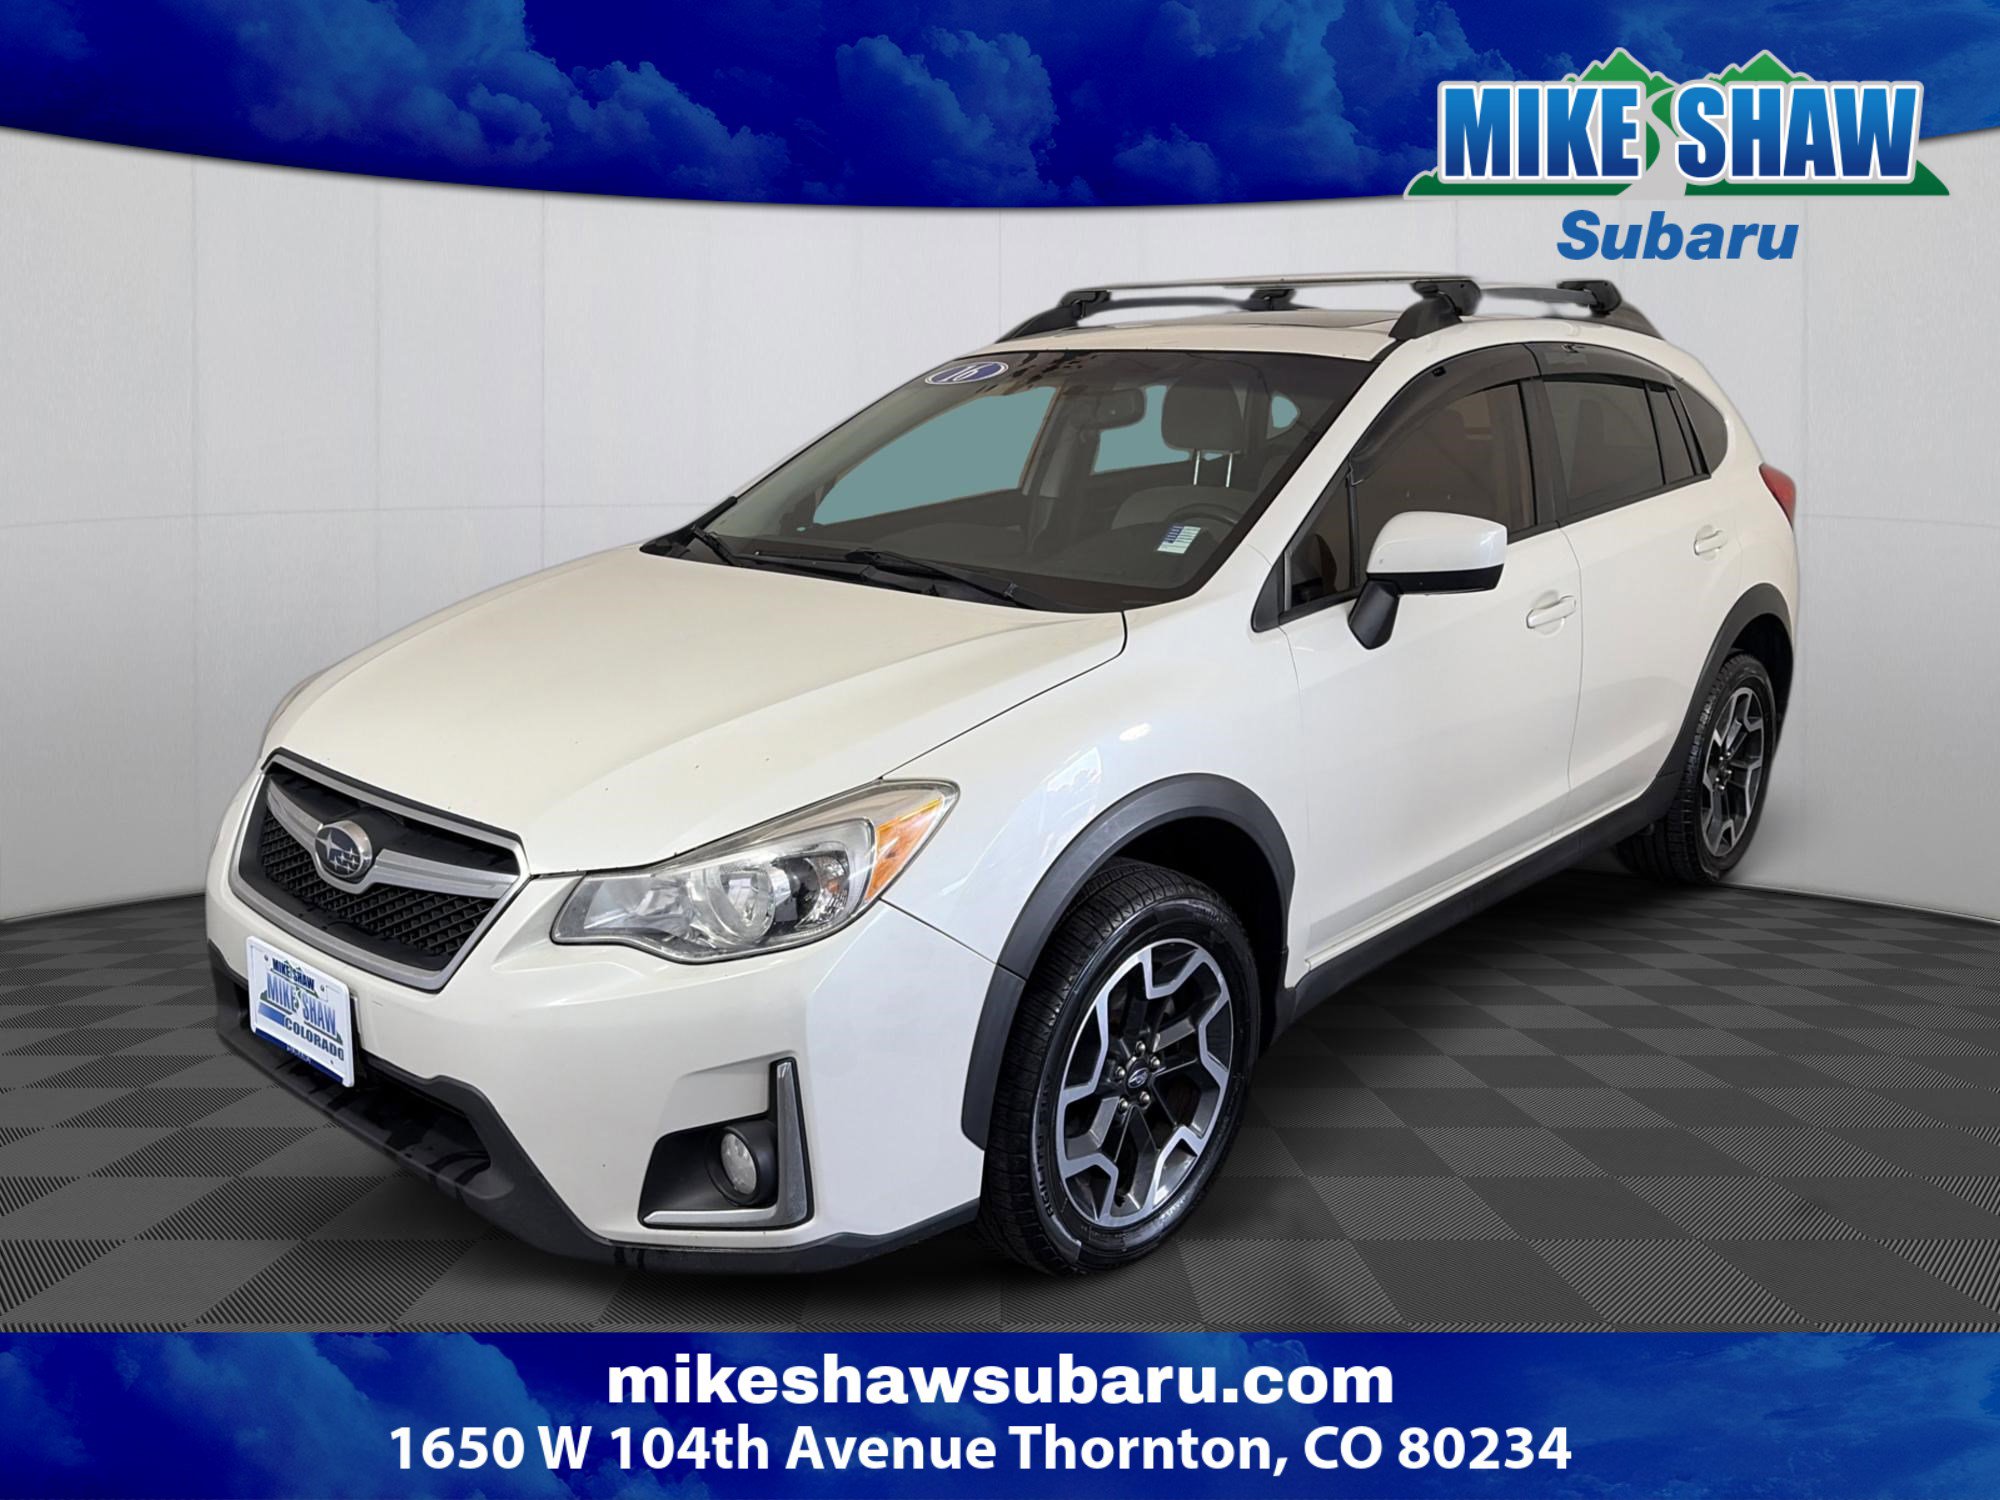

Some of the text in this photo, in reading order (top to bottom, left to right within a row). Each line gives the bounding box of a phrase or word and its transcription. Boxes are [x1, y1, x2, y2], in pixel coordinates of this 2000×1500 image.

[272, 958, 315, 991] MIKE SHAW
[266, 973, 336, 1035] MIKE SHAW
[284, 1017, 345, 1062] COLORADO
